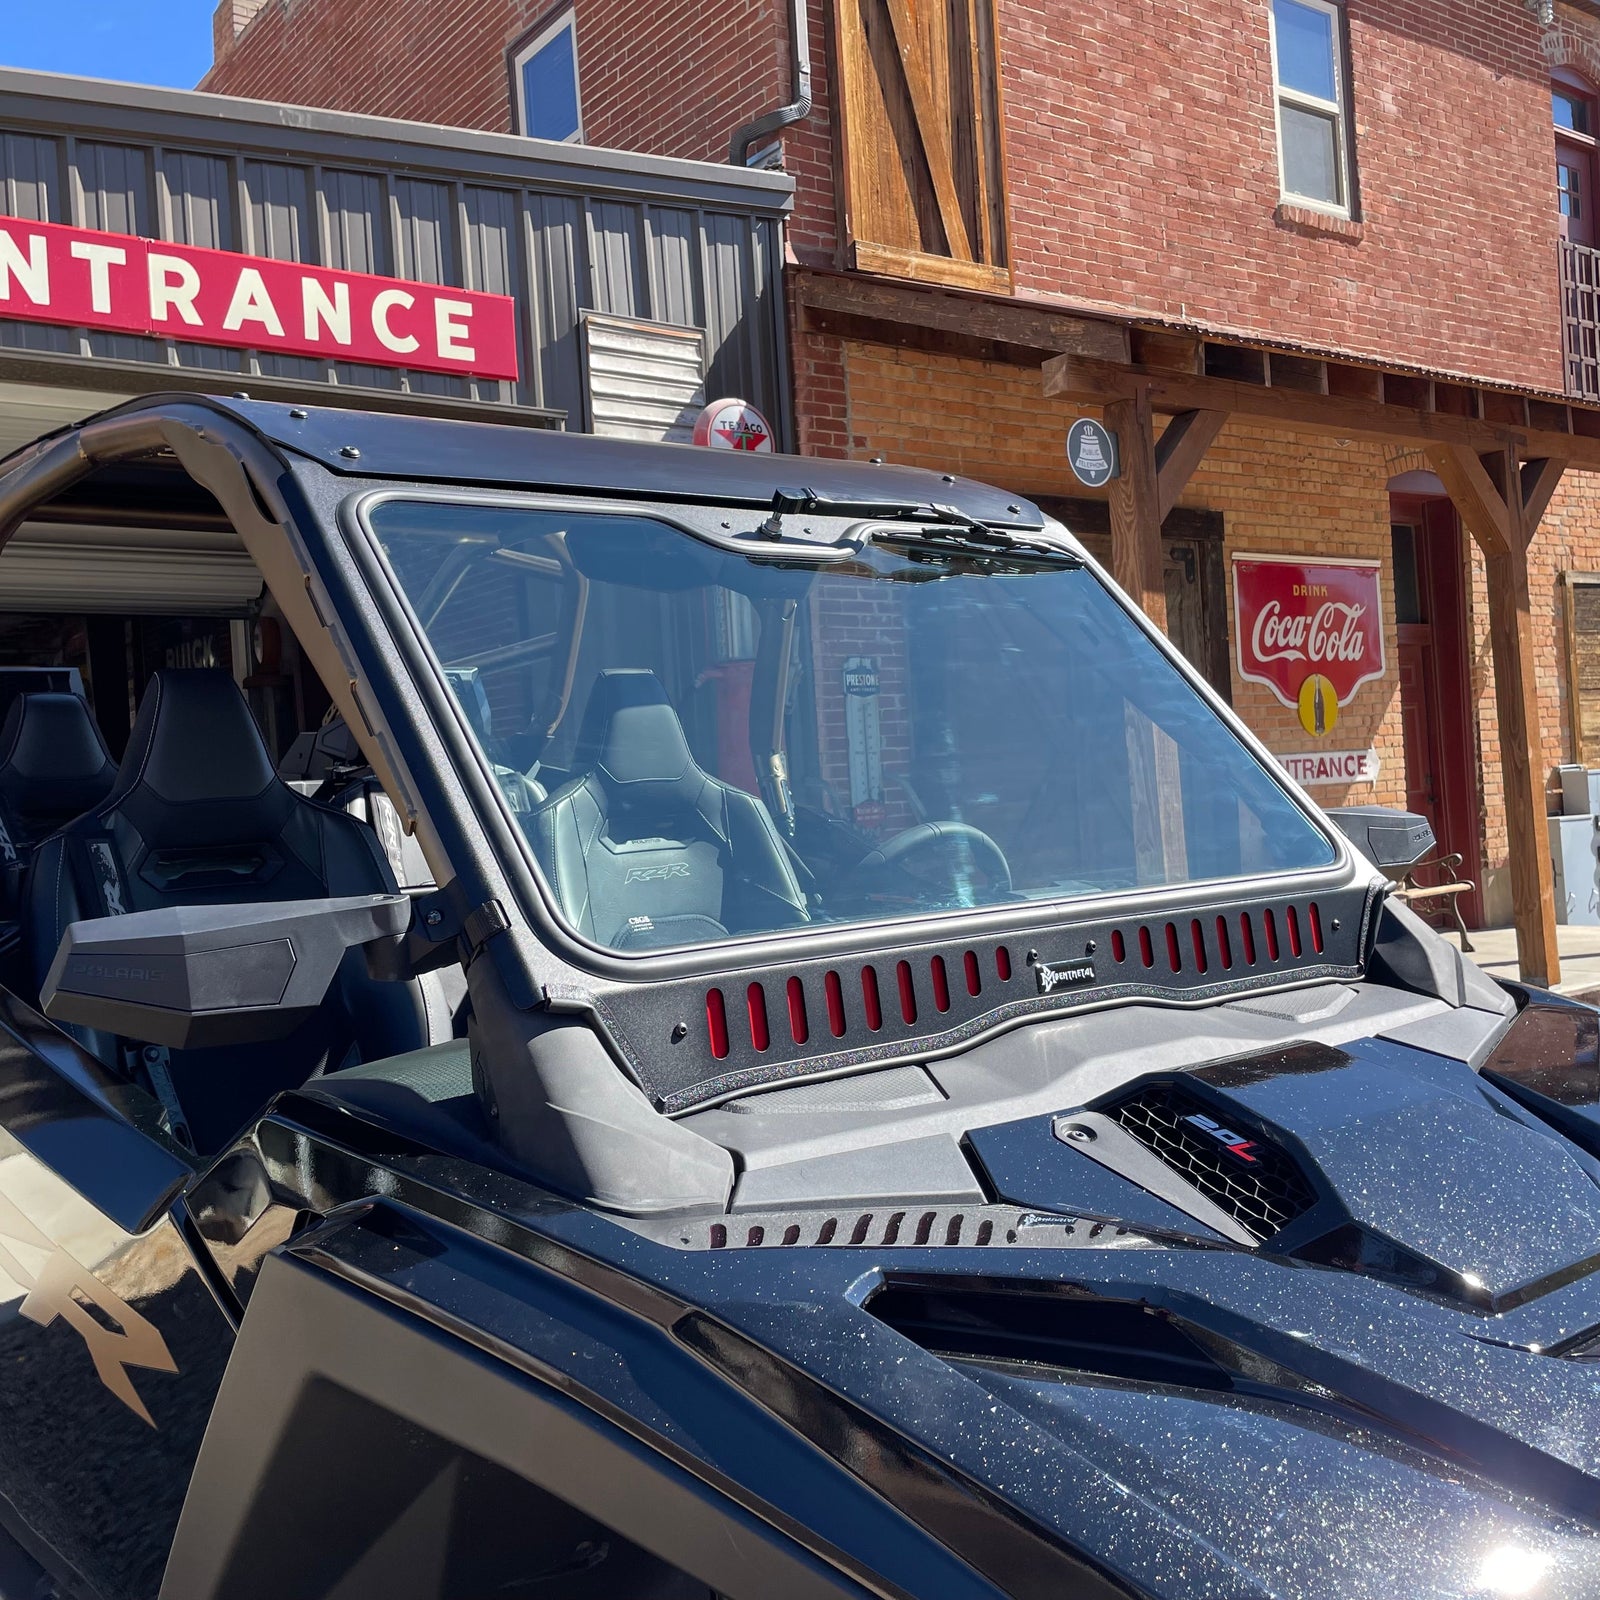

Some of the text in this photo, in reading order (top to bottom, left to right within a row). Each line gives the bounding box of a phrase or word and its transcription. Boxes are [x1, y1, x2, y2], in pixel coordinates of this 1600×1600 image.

[0, 229, 475, 362] NTRANCE
[720, 421, 763, 433] TEXACO
[1293, 585, 1328, 597] DRINK
[846, 674, 880, 686] PRESTONE
[624, 862, 690, 885] RZR
[1184, 1113, 1257, 1161] 2.0L
